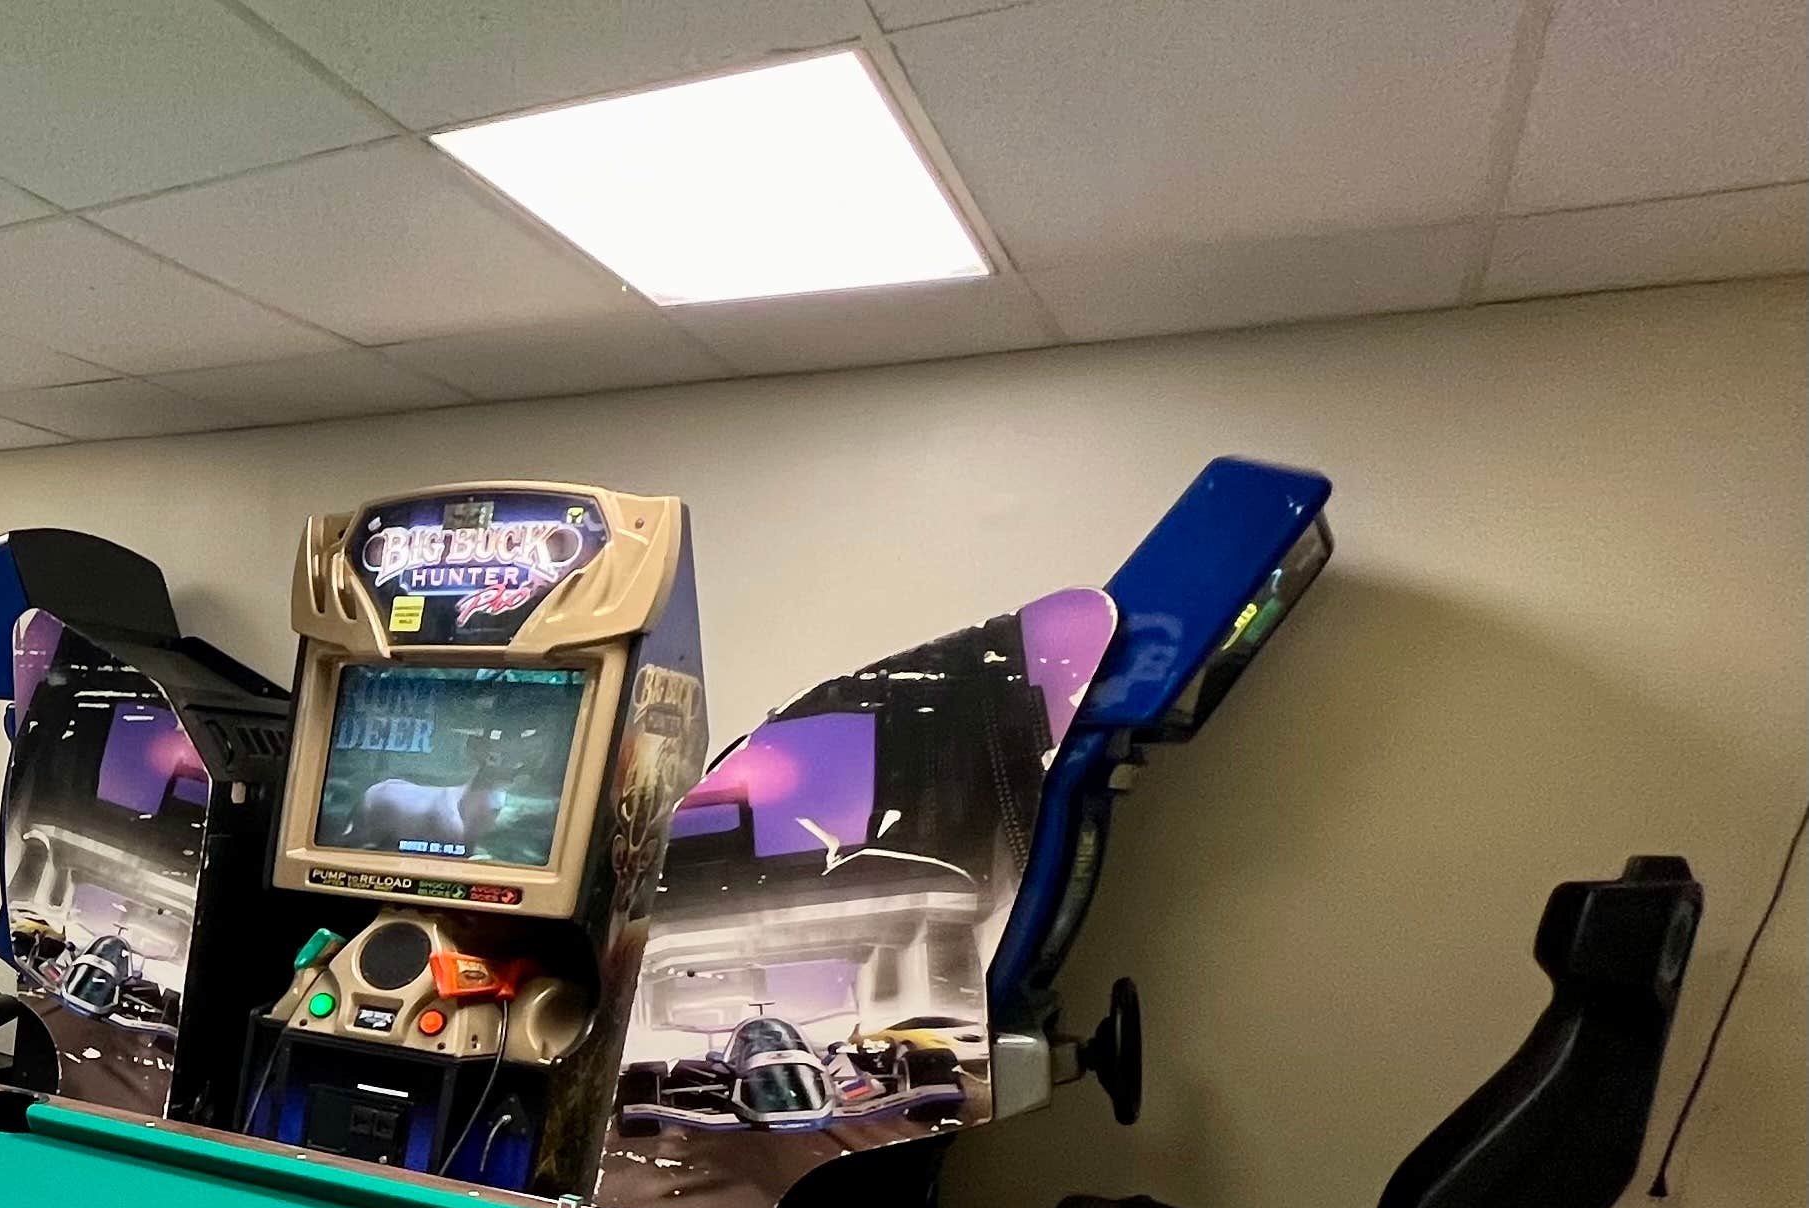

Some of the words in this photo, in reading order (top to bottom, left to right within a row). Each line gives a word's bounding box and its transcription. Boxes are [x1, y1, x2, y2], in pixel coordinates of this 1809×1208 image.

[375, 526, 446, 586] BIG
[446, 520, 558, 582] BUCK
[411, 566, 520, 588] HUNTER
[335, 716, 434, 754] DEER
[312, 868, 347, 881] PUMP
[359, 874, 412, 889] RELOAD
